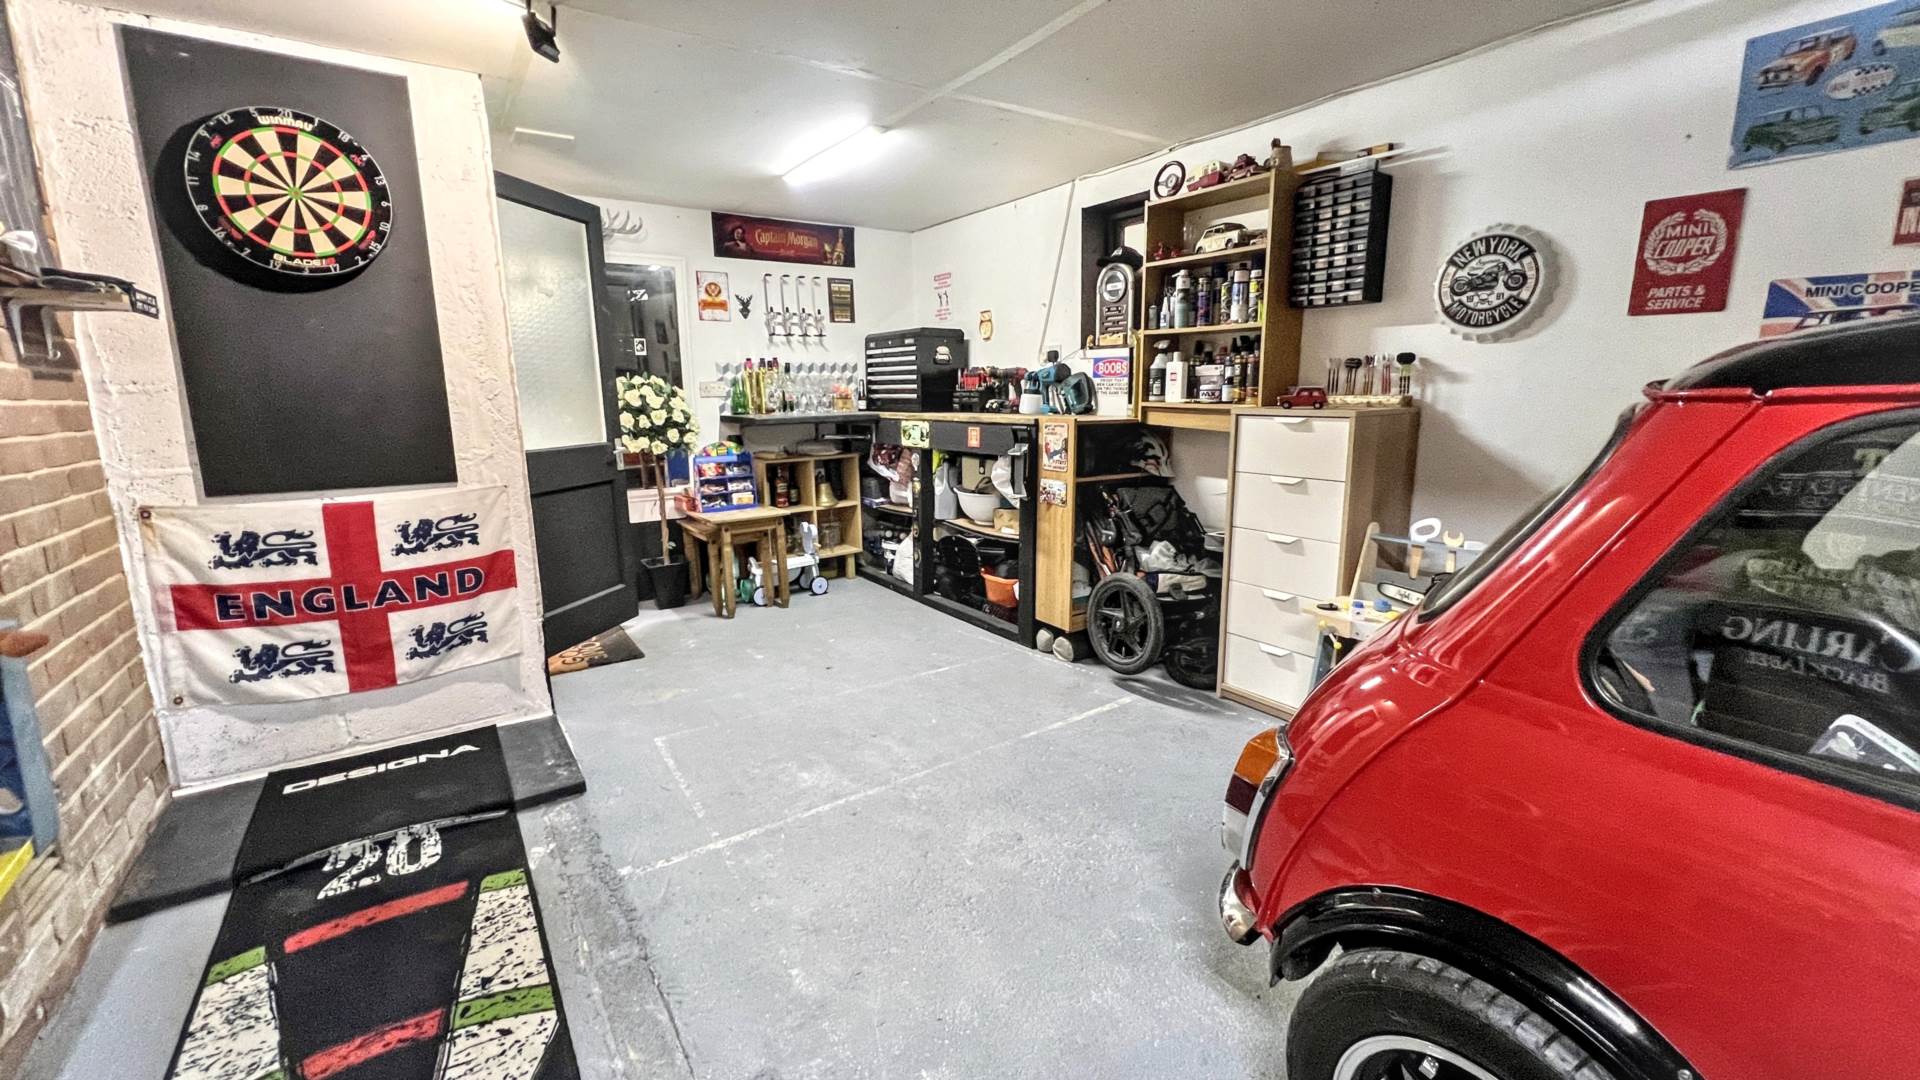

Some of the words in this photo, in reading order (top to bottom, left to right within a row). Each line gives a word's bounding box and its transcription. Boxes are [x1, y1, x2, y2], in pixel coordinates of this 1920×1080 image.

[220, 113, 234, 125] 12
[337, 130, 353, 143] 18
[187, 151, 201, 162] 14
[186, 176, 200, 185] 11
[374, 176, 386, 185] 13
[213, 226, 227, 239] 16
[378, 221, 390, 232] 10
[1666, 222, 1711, 239] MINI
[754, 228, 787, 247] Captain
[785, 231, 819, 250] Morgan
[368, 241, 381, 253] 15
[1452, 238, 1487, 268] NEW
[1489, 236, 1529, 261] YORK
[1654, 236, 1718, 259] COOPER
[329, 263, 340, 274] 17
[1647, 285, 1693, 299] PARTS
[1694, 284, 1706, 297] &
[1804, 284, 1845, 299] MINI
[1447, 296, 1524, 326] MOTORCYCLE
[1645, 296, 1706, 311] SERVICE
[1099, 361, 1128, 374] BOOBS
[215, 567, 485, 622] ENGLAND
[282, 744, 480, 795] DESIGNA
[317, 824, 443, 900] 20
